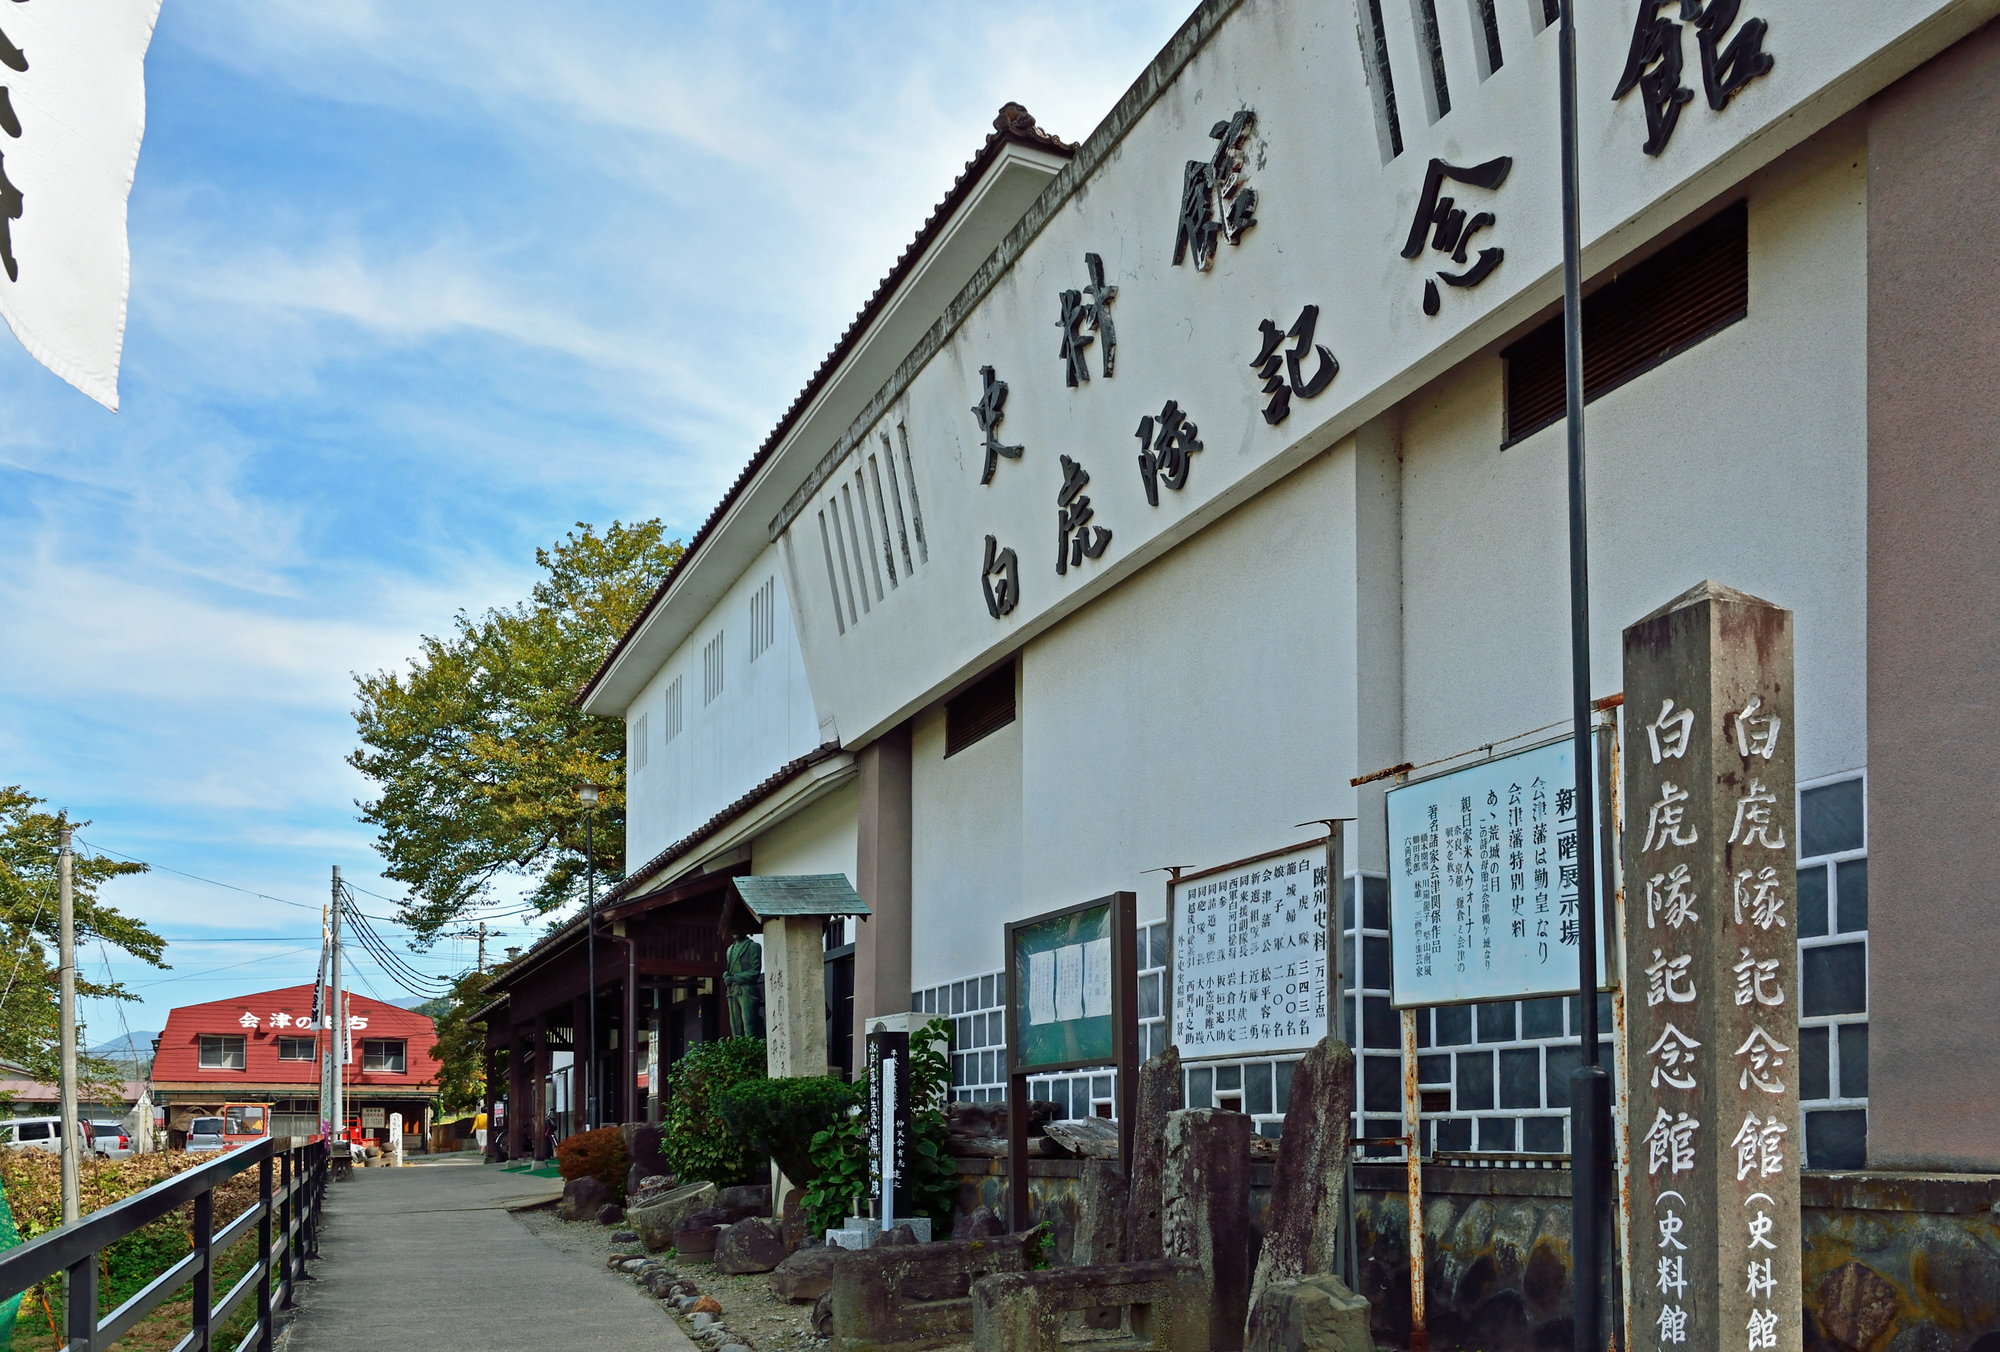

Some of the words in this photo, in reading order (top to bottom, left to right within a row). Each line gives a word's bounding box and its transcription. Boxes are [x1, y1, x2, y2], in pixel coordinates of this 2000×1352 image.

[1313, 866, 1328, 952] 陳列史料
[1507, 782, 1526, 938] 会津藩特別史料
[1531, 776, 1550, 965] 会津藩は勤皇なり
[1314, 957, 1325, 1018] 一万二千点
[1641, 697, 1703, 1352] 白虎隊記念館（史料館
